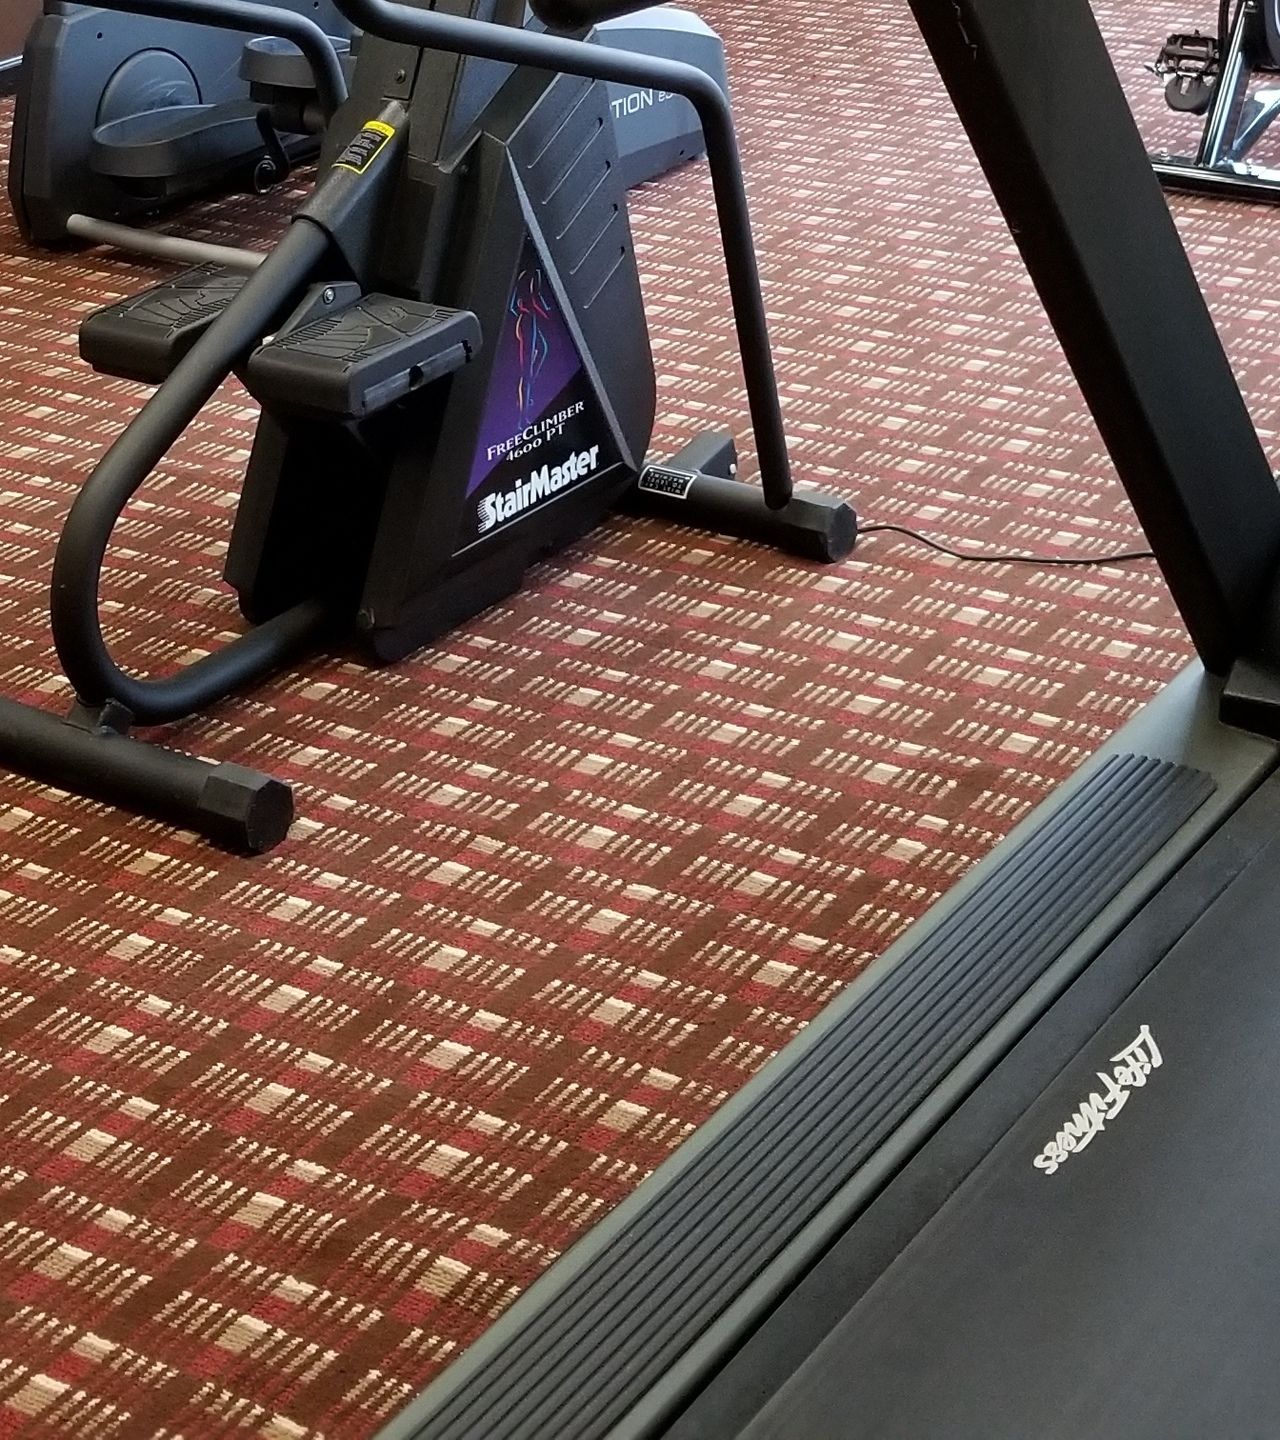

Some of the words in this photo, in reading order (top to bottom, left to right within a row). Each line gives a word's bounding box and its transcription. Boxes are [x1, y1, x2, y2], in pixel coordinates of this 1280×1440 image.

[609, 88, 653, 119] TION
[506, 438, 542, 462] 4600
[546, 422, 566, 442] PT
[477, 444, 600, 534] StairMaster
